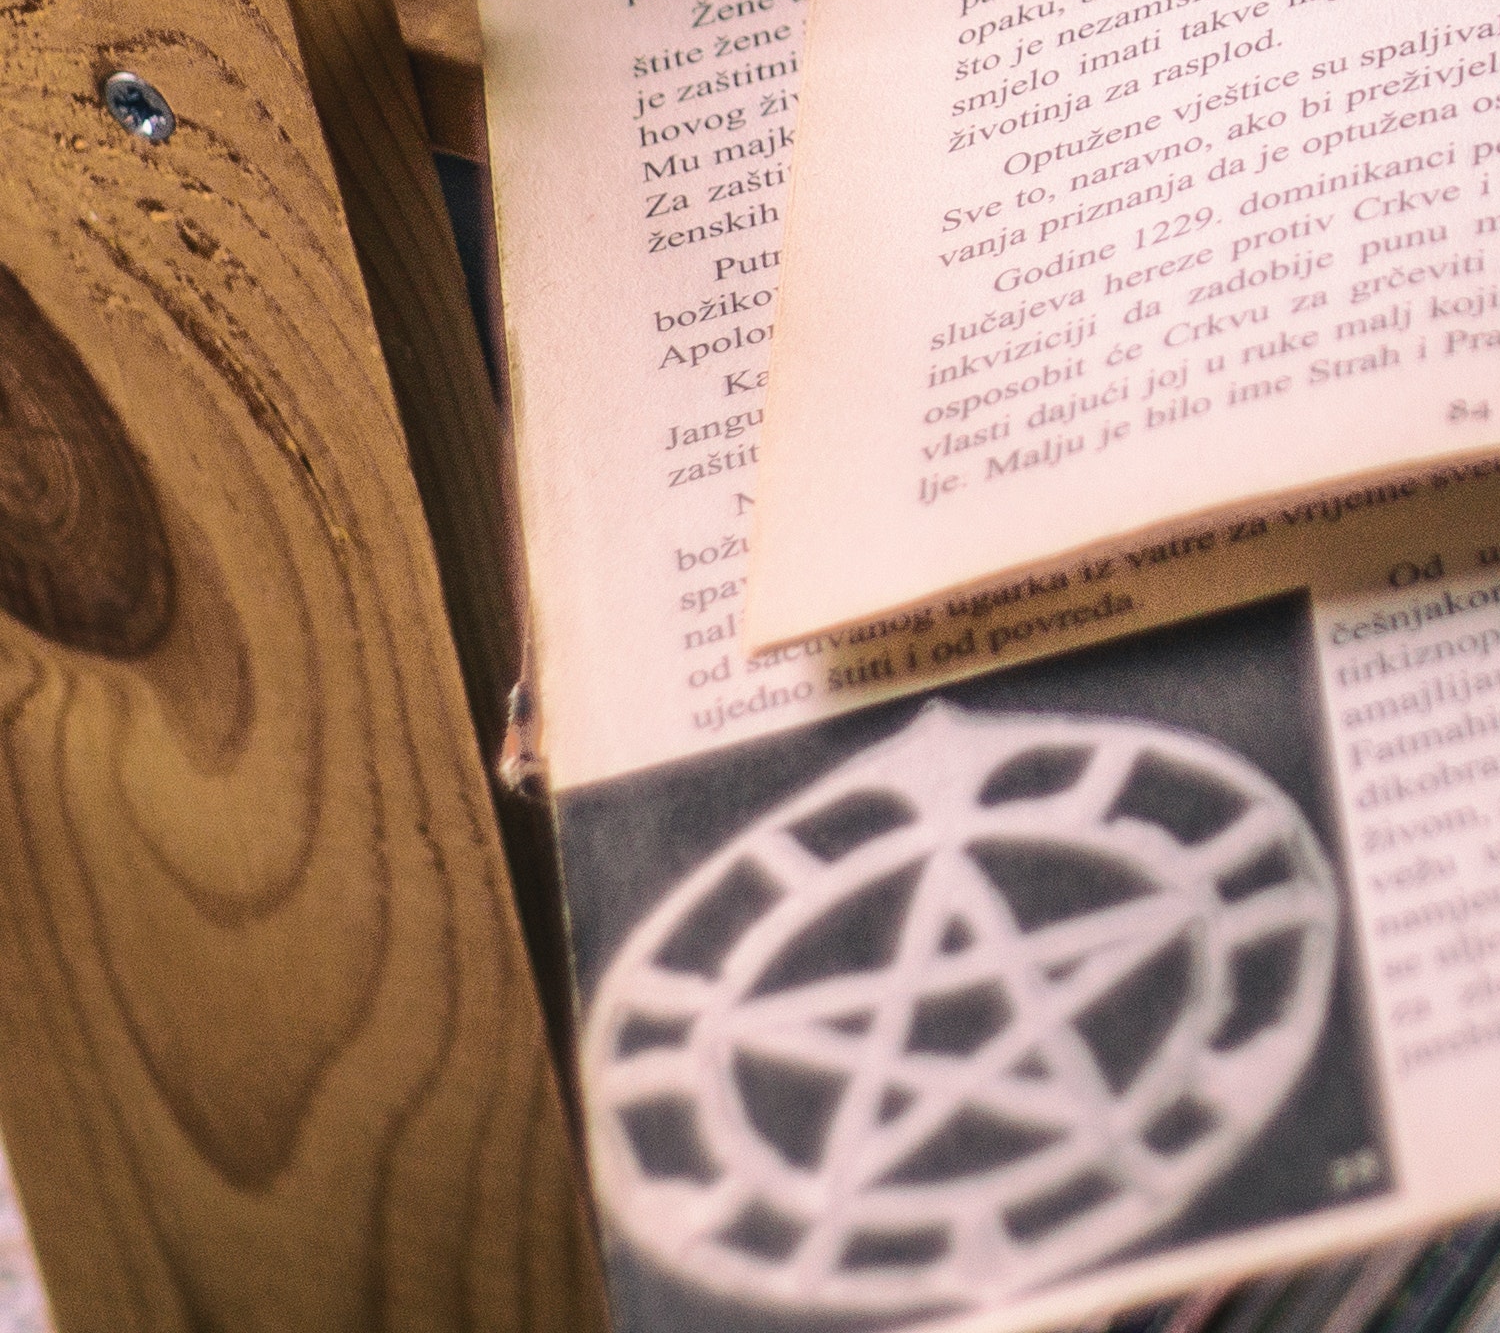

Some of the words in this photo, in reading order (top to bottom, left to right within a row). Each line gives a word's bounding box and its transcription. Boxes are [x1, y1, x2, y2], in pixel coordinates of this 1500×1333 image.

[632, 41, 704, 79] štite
[713, 22, 791, 58] žene
[947, 90, 1093, 150] životinja
[1104, 78, 1141, 101] za
[1152, 24, 1283, 86] rasplod.
[951, 65, 1061, 116] smjelo
[1079, 25, 1161, 74] imati
[1180, 1, 1270, 41] takve
[632, 88, 666, 119] je
[639, 103, 746, 148] hovog
[1002, 113, 1162, 178] Optužene
[1172, 71, 1300, 122] vještice
[1310, 57, 1348, 80] su
[641, 155, 701, 184] Mu
[938, 225, 1027, 268] vanja
[1038, 171, 1195, 242] priznanja
[1205, 156, 1246, 183] da
[1254, 143, 1290, 175] je
[1301, 103, 1459, 155] optužena
[941, 201, 1003, 232] Sve
[1015, 186, 1056, 208] to,
[1069, 136, 1213, 190] naravno,
[1225, 107, 1288, 140] ako
[1300, 89, 1332, 119] bi
[645, 194, 690, 219] Za
[647, 203, 780, 254] ženskih
[992, 243, 1116, 295] Godine
[1135, 204, 1222, 249] 1229.
[1237, 141, 1456, 217] dominikanci
[929, 288, 1086, 351] slučajeva
[1103, 248, 1214, 294] hereze
[1230, 211, 1334, 261] protiv
[1351, 186, 1461, 222] Crkve
[1479, 171, 1491, 195] i
[1387, 557, 1446, 591] Od
